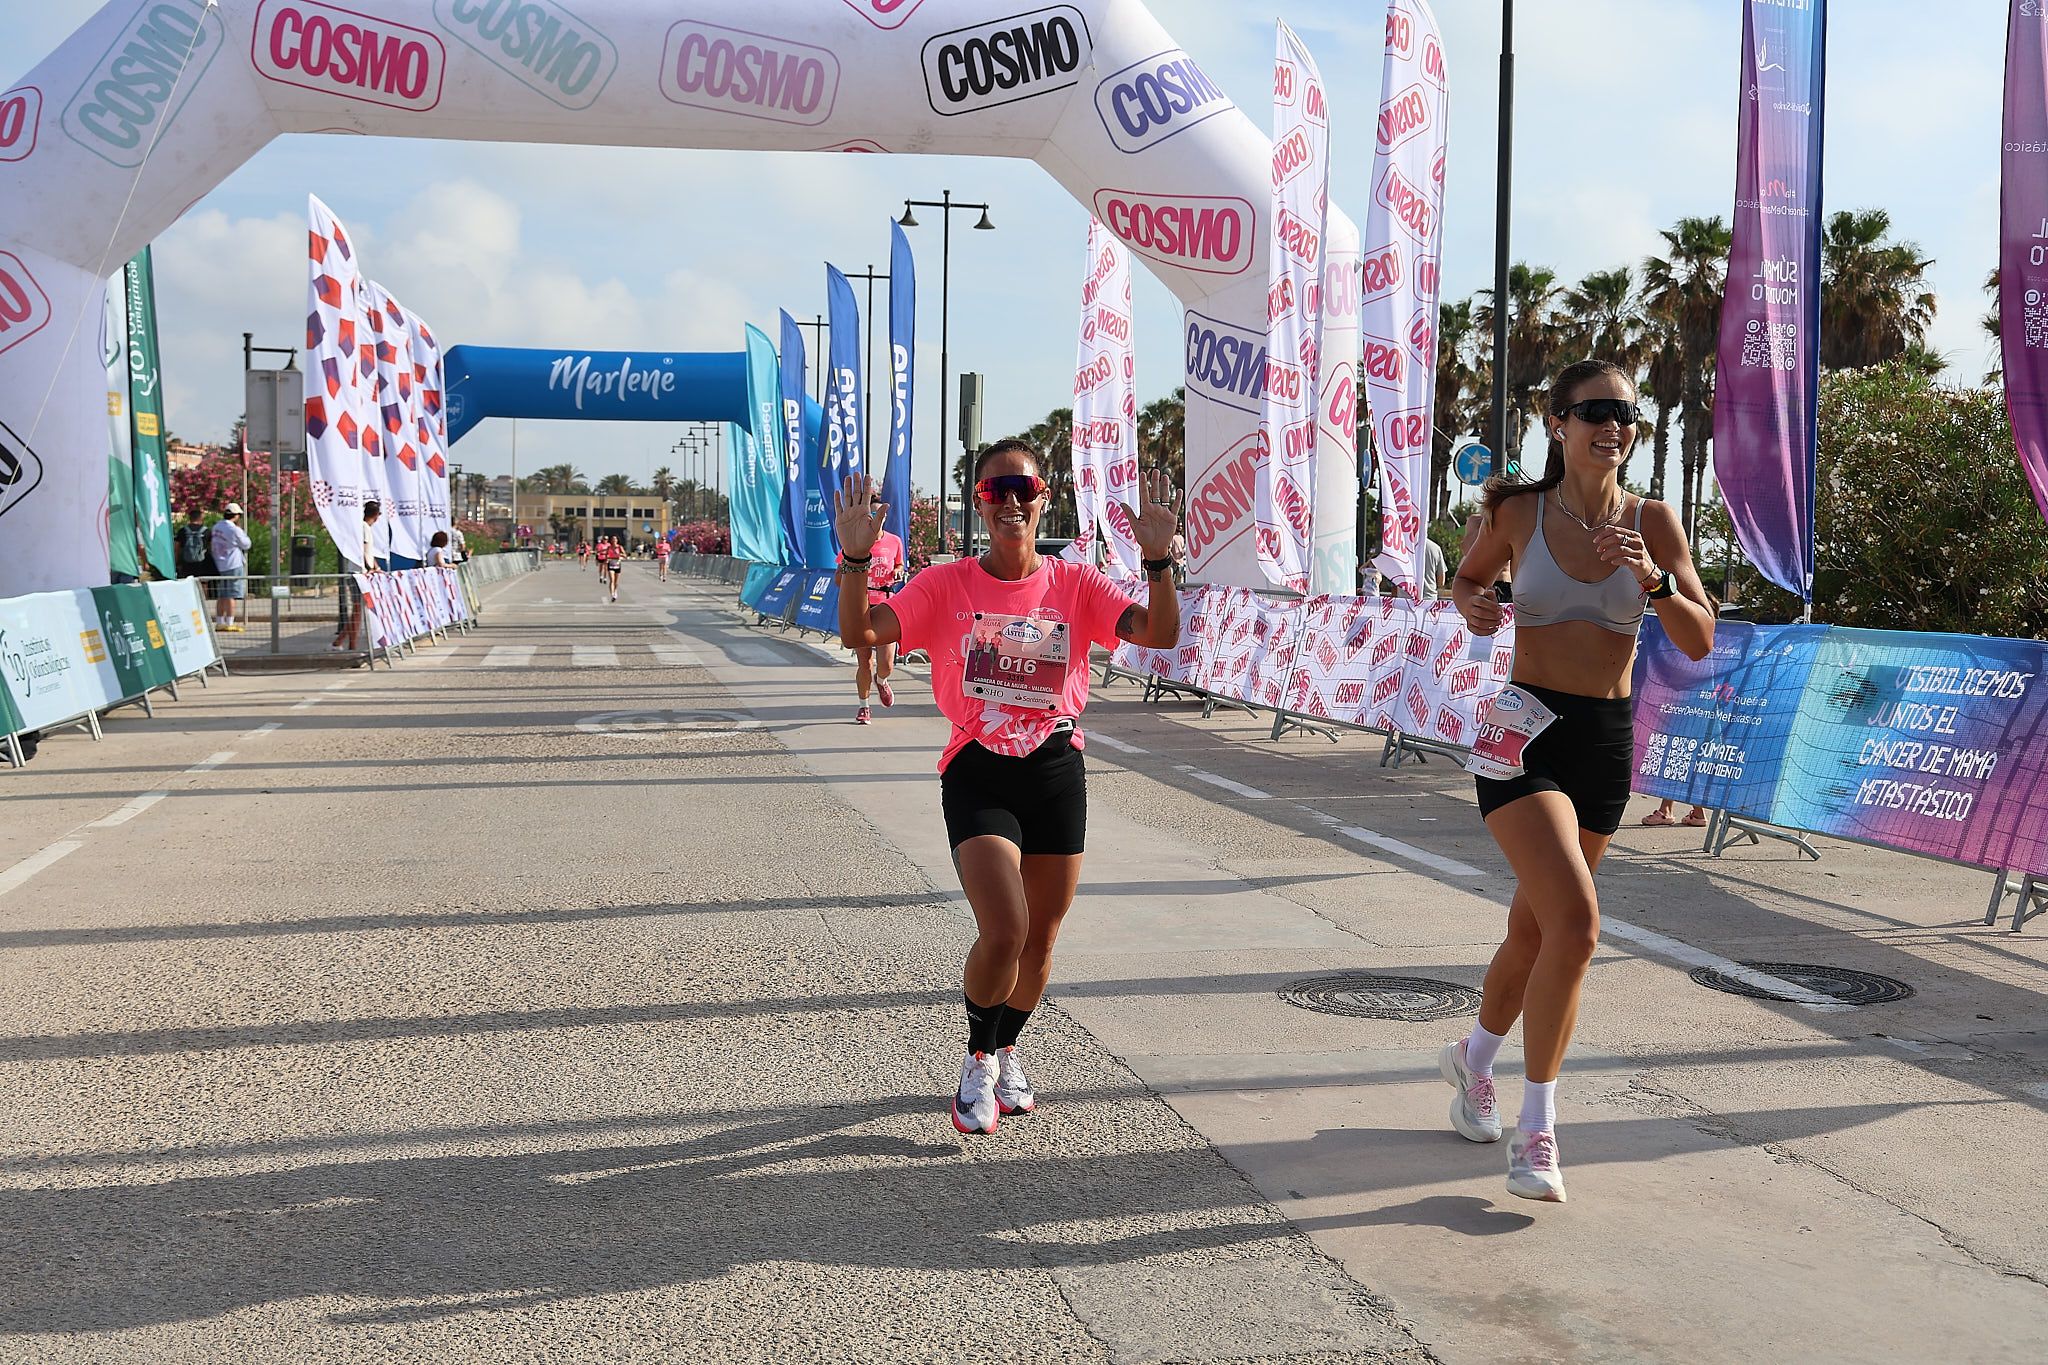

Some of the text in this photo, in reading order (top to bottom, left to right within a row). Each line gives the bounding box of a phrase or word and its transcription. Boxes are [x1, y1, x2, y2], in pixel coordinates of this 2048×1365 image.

[270, 8, 428, 99] COSMO
[938, 16, 1080, 103] COSMO
[78, 4, 206, 149] COSMO
[676, 33, 825, 115] COSMO
[1111, 57, 1226, 137] COSM
[1107, 199, 1241, 262] COSMO
[1185, 323, 1266, 400] COSM
[550, 356, 675, 409] Marlene
[1004, 627, 1041, 640] ASTURIANA
[1348, 619, 1373, 660] COSMO
[1371, 633, 1398, 666] COSMO
[1405, 632, 1430, 661] COSMO
[999, 655, 1037, 675] 016
[1152, 654, 1171, 678] COSMO
[1434, 630, 1463, 678] COSMO
[1493, 651, 1510, 677] COS
[973, 676, 997, 685] CARRERA
[1031, 685, 1054, 693] VALENCIA
[1336, 682, 1364, 703] COSMO
[1373, 671, 1401, 704] COSMO
[1451, 665, 1479, 695] COSMO
[1895, 665, 2036, 699] VISIBILICEMOS
[1022, 695, 1052, 705] Santander
[1407, 682, 1429, 728] COSMO
[1437, 709, 1462, 744] COSMO
[1481, 723, 1506, 743] 016
[1867, 701, 1959, 735] JUNTOS EL
[1698, 738, 1739, 762] SÚMATE
[1858, 733, 1999, 780] CÁNCER DE MAMA
[1854, 778, 1975, 822] METASTÁSICO
